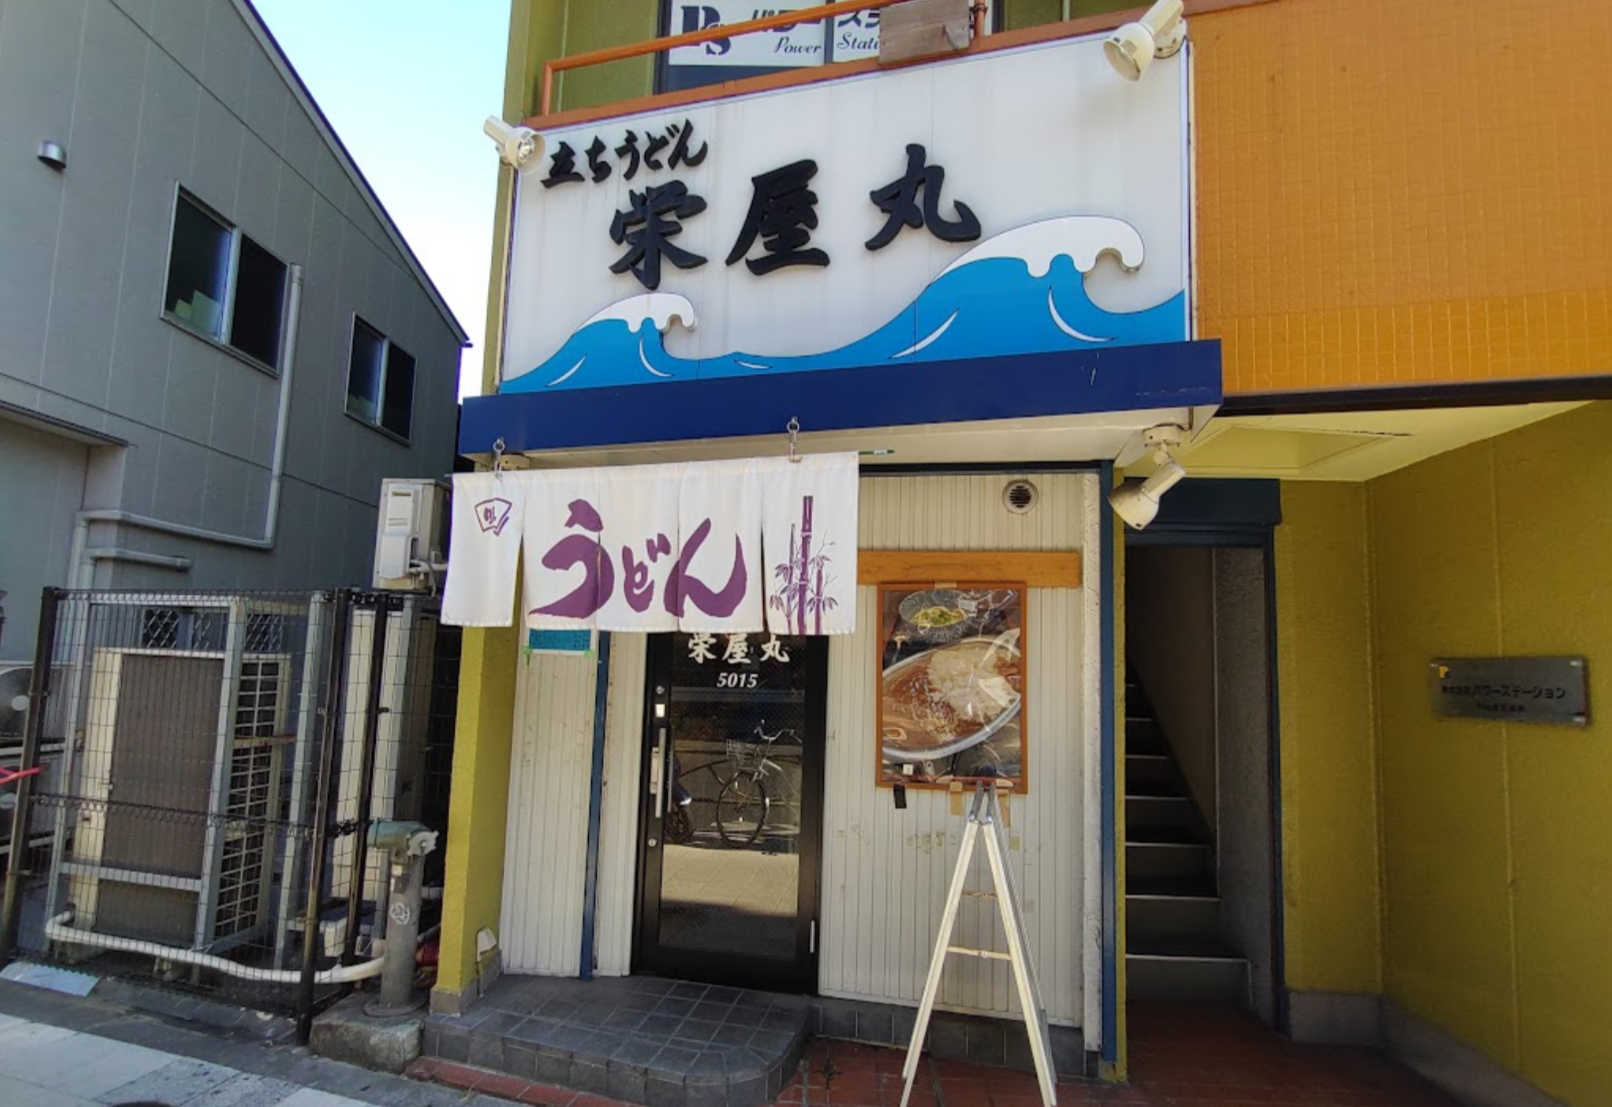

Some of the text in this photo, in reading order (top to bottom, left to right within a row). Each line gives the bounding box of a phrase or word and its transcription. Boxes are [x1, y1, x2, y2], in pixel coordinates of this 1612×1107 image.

[774, 32, 822, 54] Power
[541, 118, 707, 188] 立ちうどん
[609, 143, 981, 290] 栄屋丸
[528, 499, 747, 619] うどん
[688, 633, 790, 664] 栄屋丸
[716, 672, 758, 688] 5015
